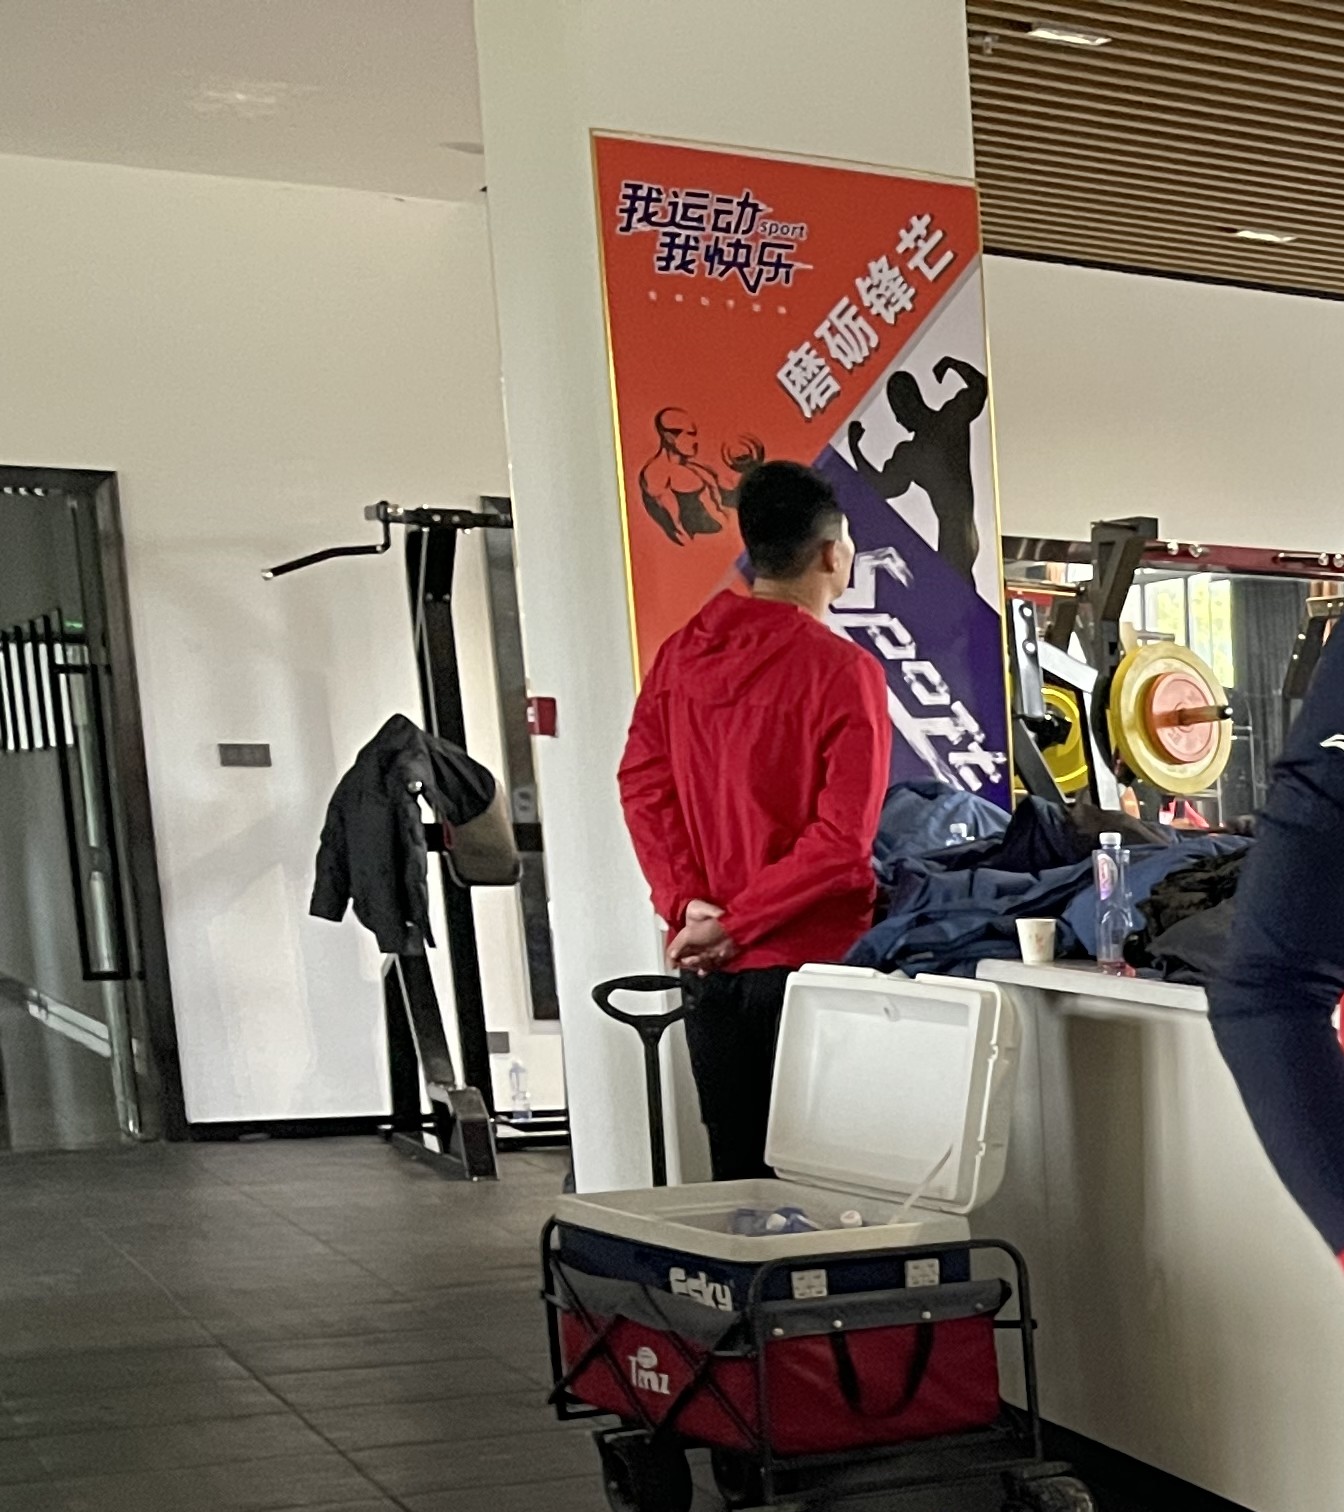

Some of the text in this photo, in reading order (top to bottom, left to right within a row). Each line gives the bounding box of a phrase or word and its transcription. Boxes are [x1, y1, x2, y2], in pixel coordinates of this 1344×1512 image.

[617, 181, 764, 235] 我运动
[759, 218, 807, 239] sport
[655, 231, 798, 294] 我快乐
[776, 212, 957, 420] 磨砺锋芒
